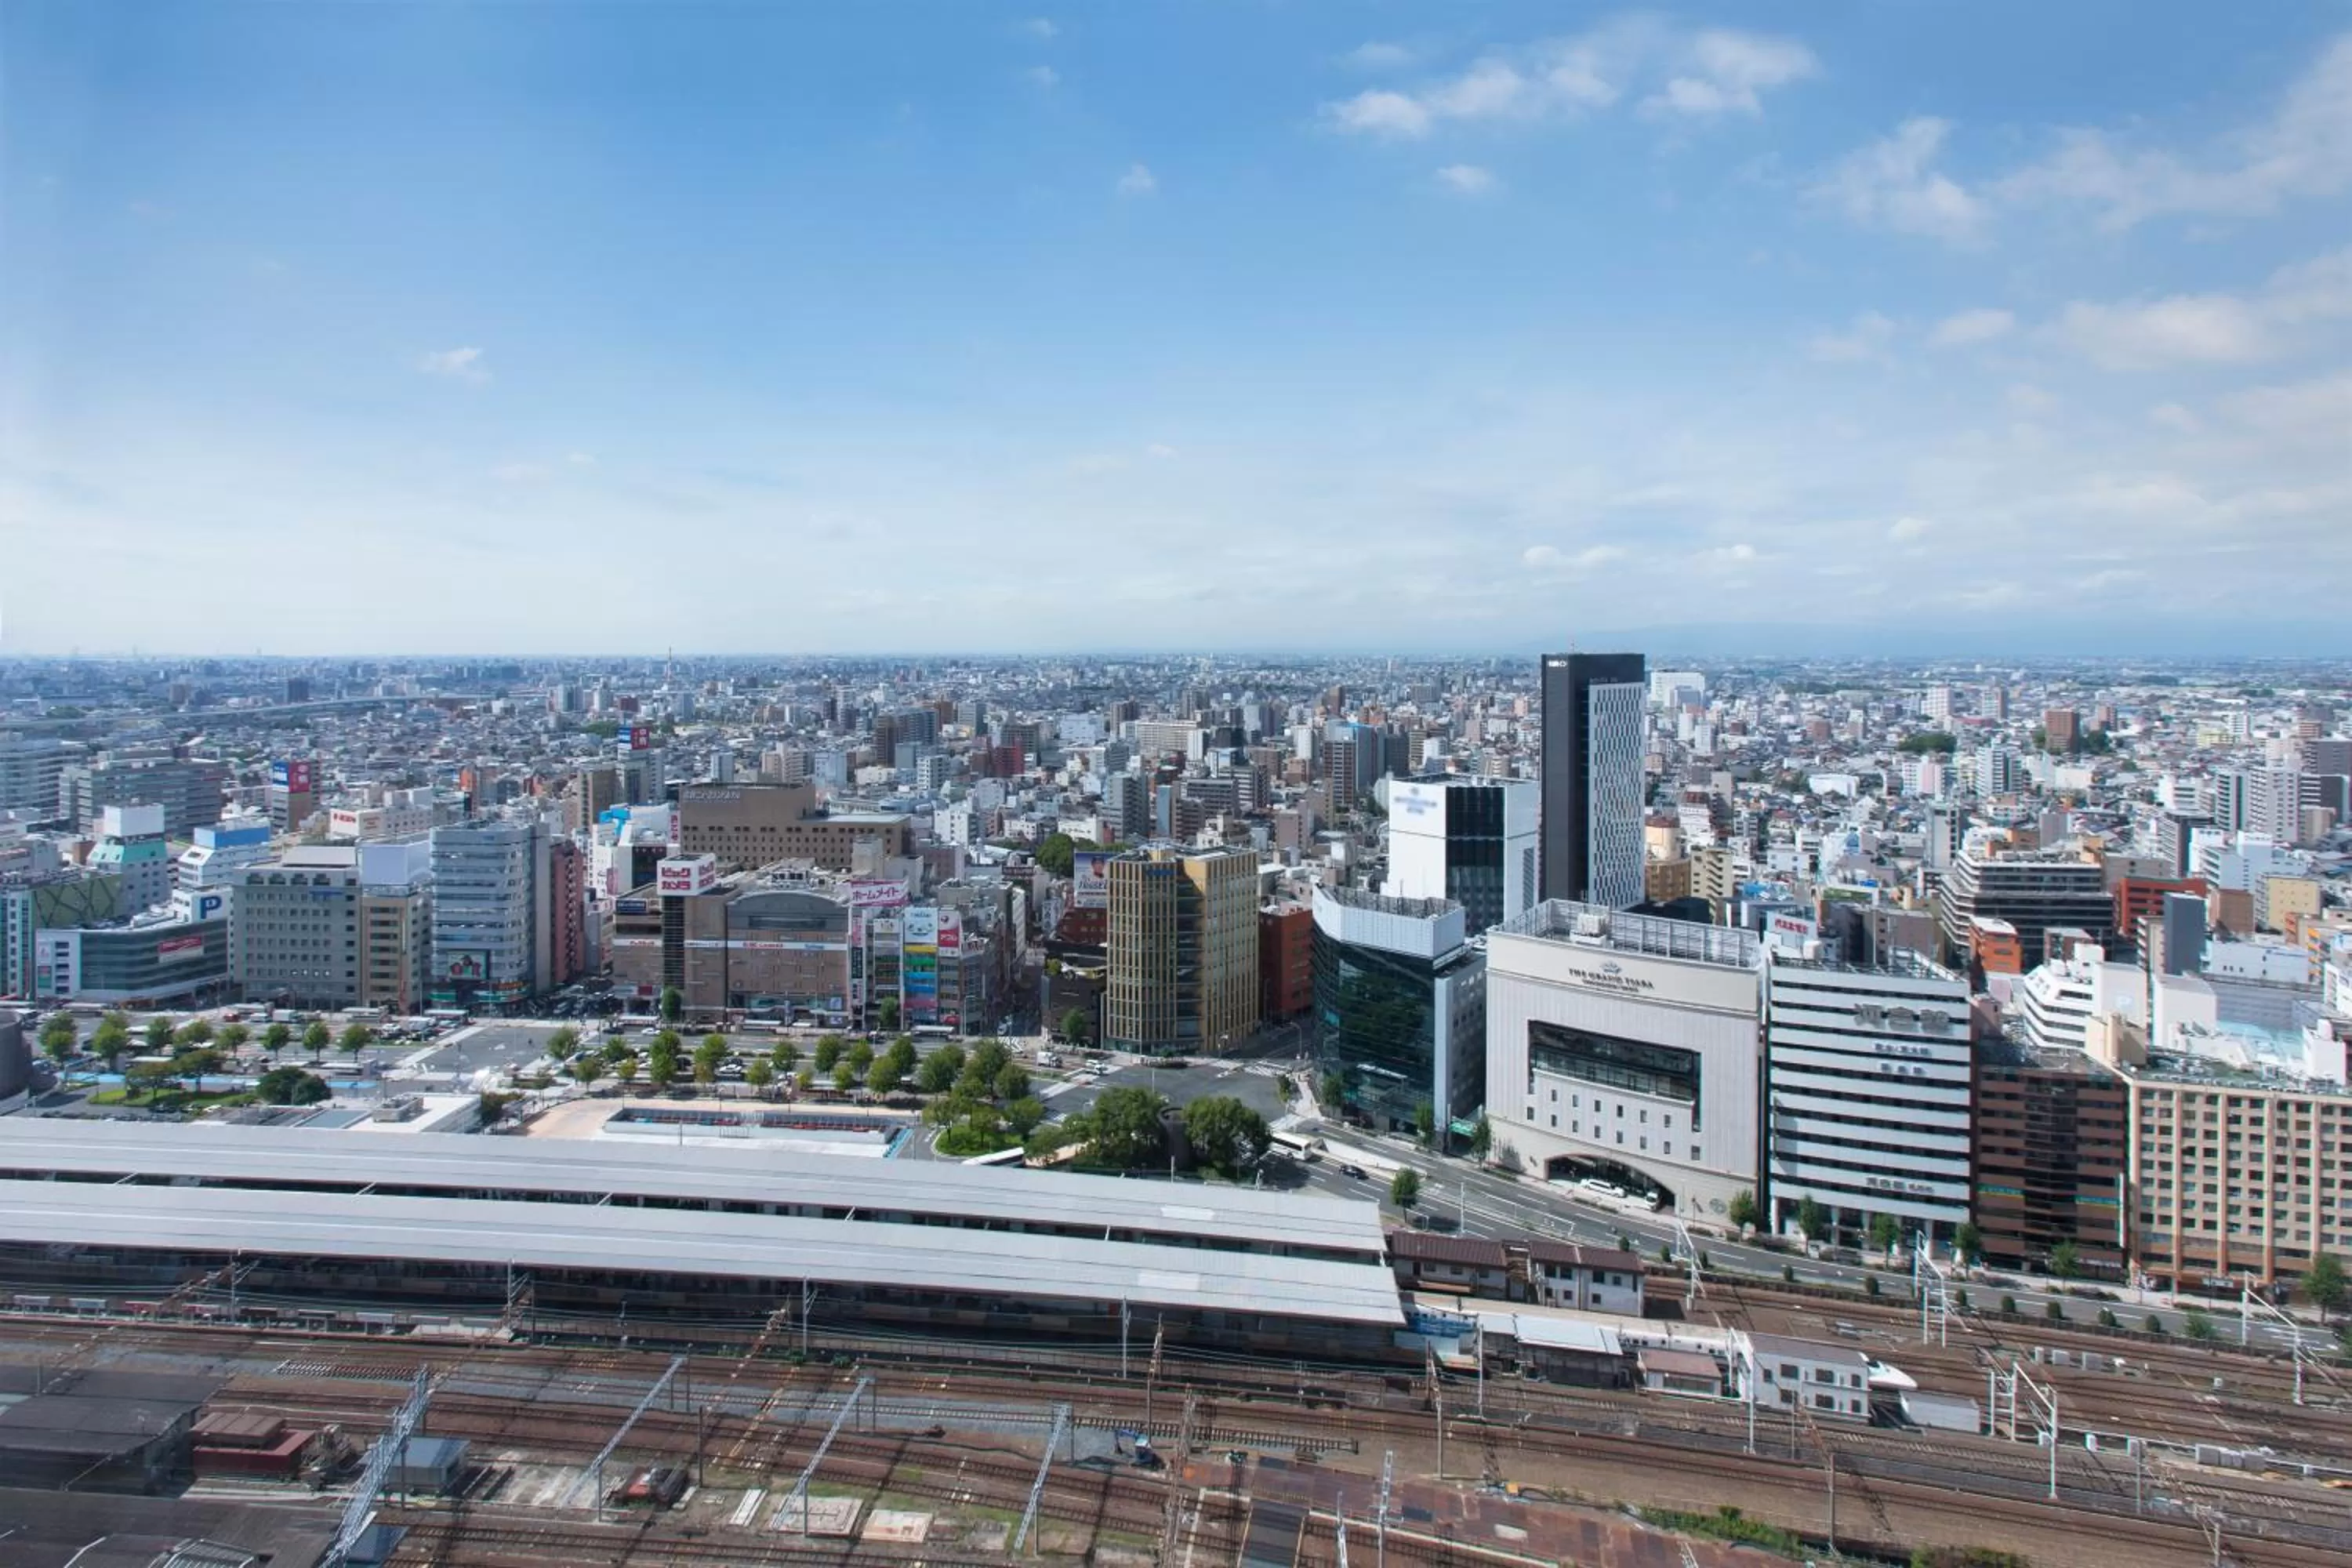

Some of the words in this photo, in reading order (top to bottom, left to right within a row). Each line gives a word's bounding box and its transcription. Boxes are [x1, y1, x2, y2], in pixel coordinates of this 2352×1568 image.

[852, 887, 900, 901] ホームメイト
[200, 896, 222, 920] P
